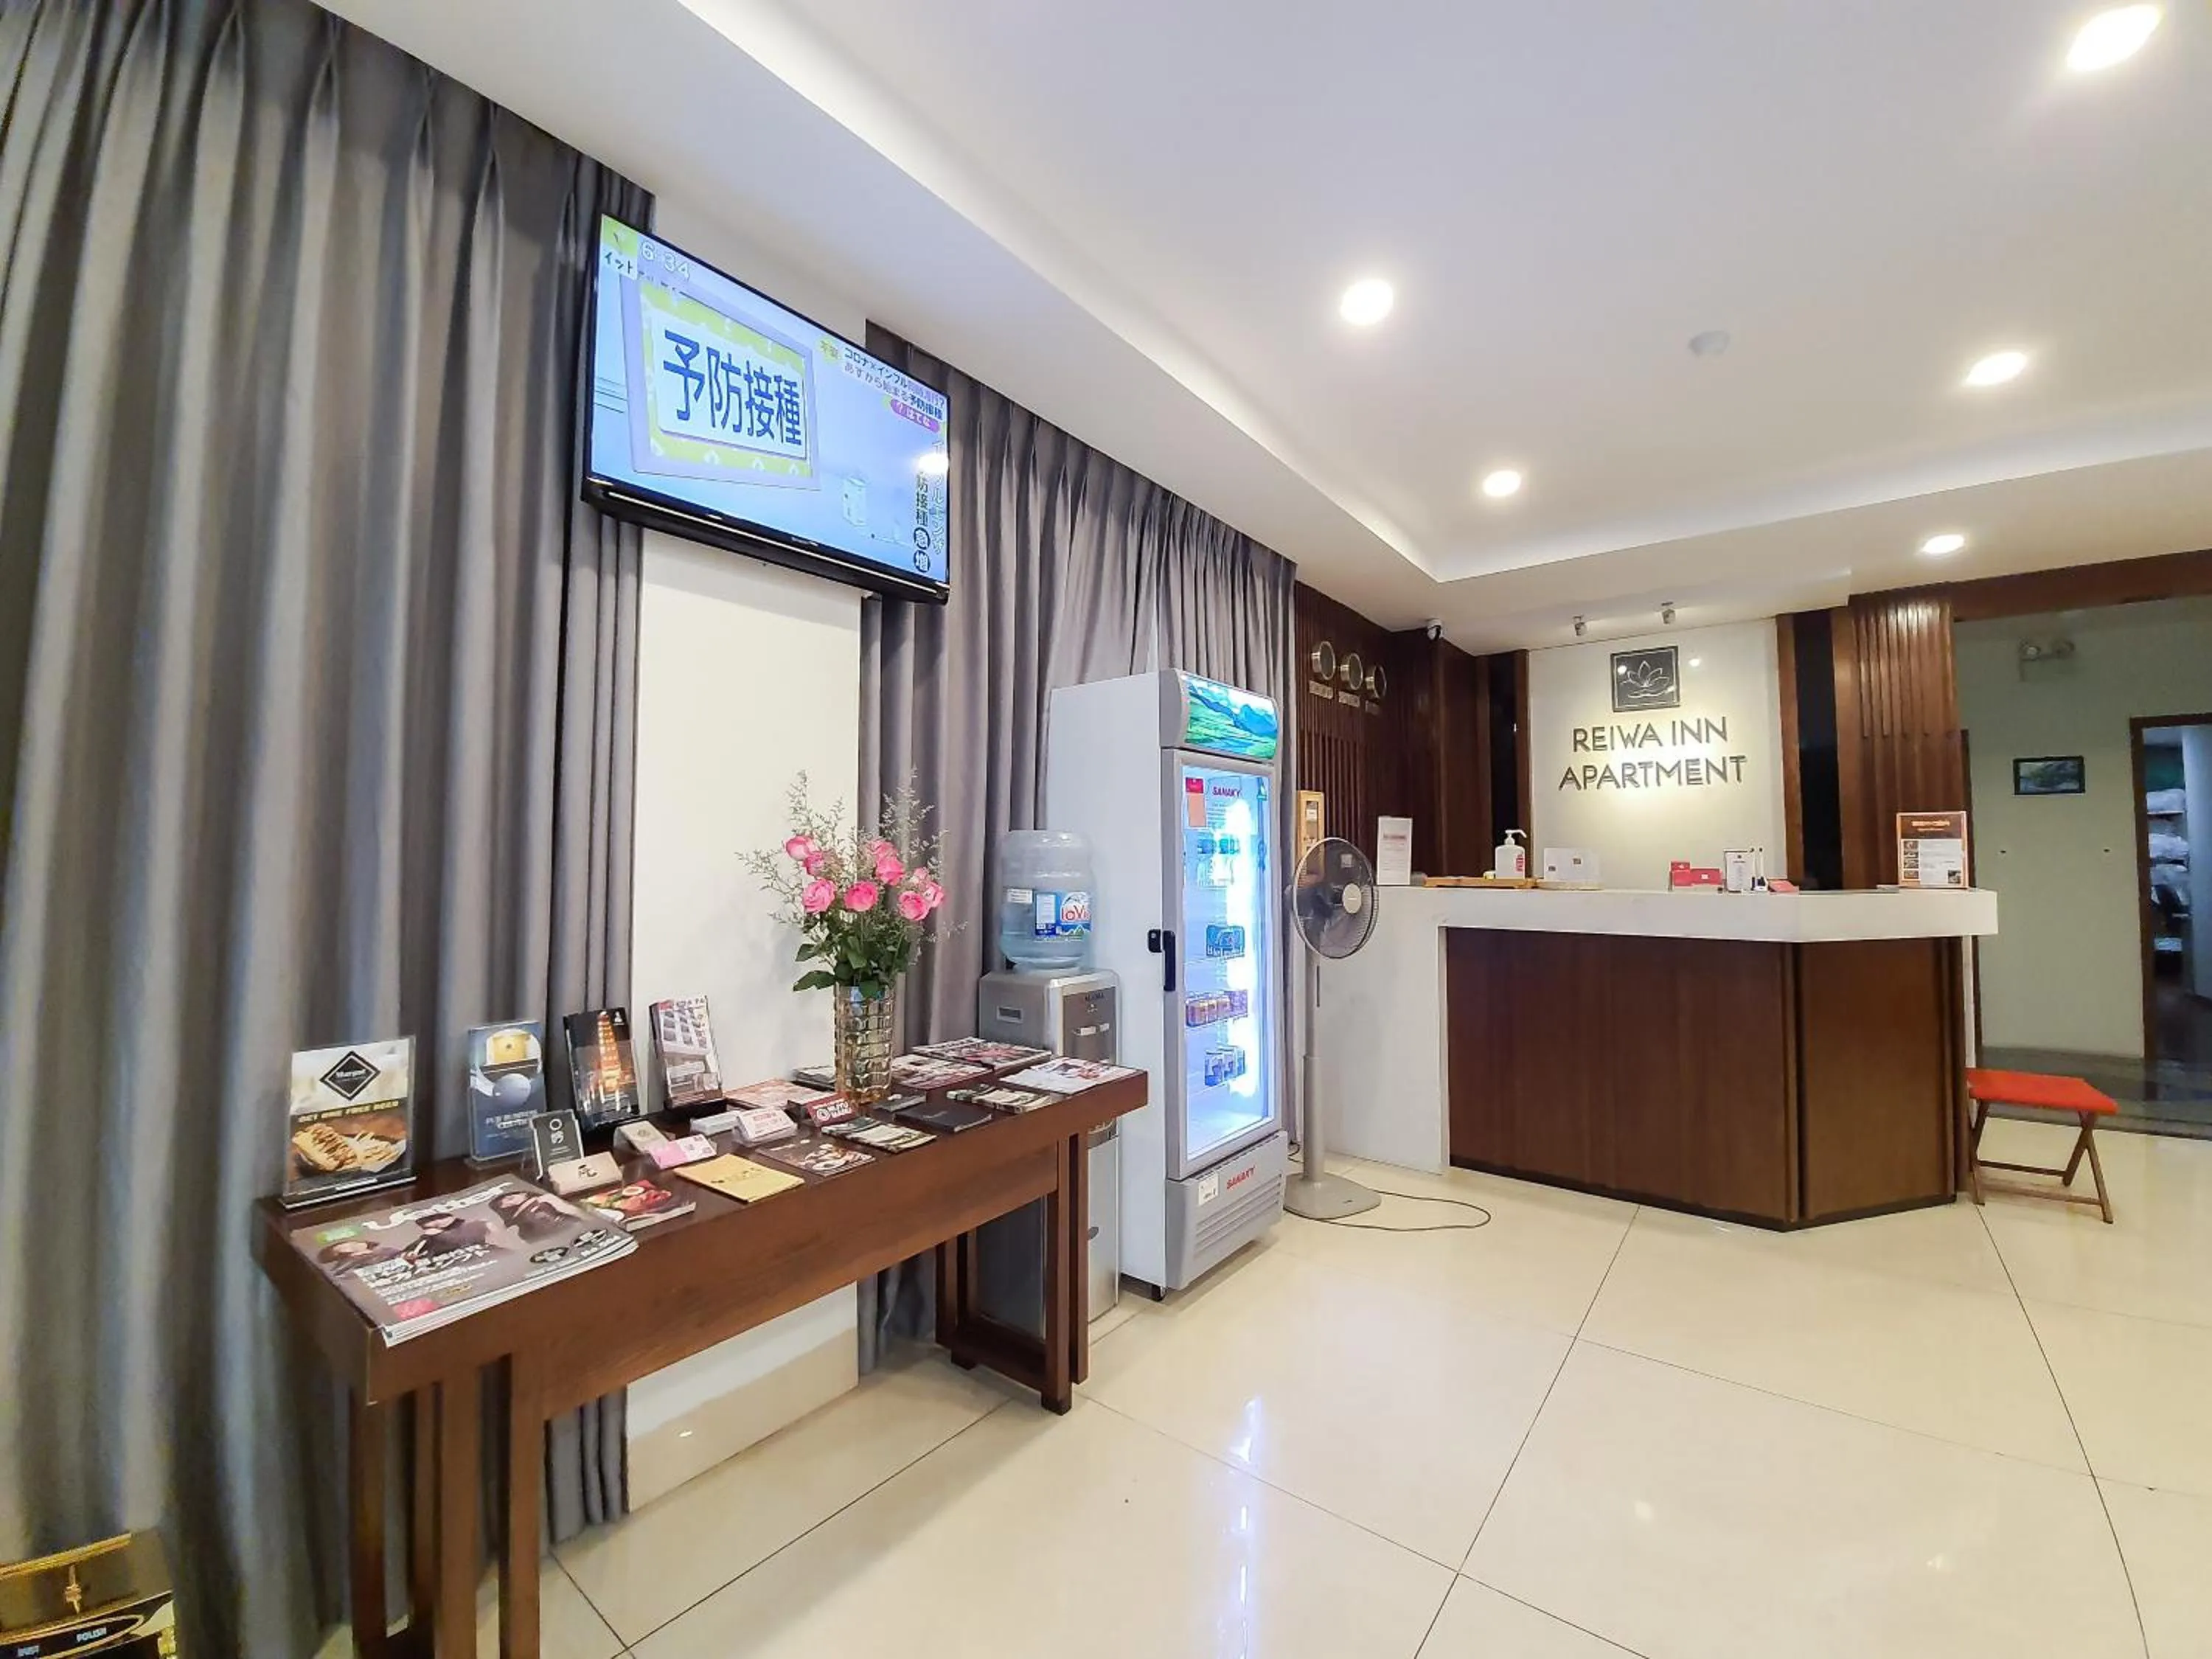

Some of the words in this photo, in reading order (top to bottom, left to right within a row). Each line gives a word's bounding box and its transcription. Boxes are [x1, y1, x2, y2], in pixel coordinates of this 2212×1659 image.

[663, 329, 802, 446] 予防接種
[1573, 722, 1663, 753] REIWA
[1672, 716, 1728, 746] INN
[1558, 755, 1747, 791] APARTMENT
